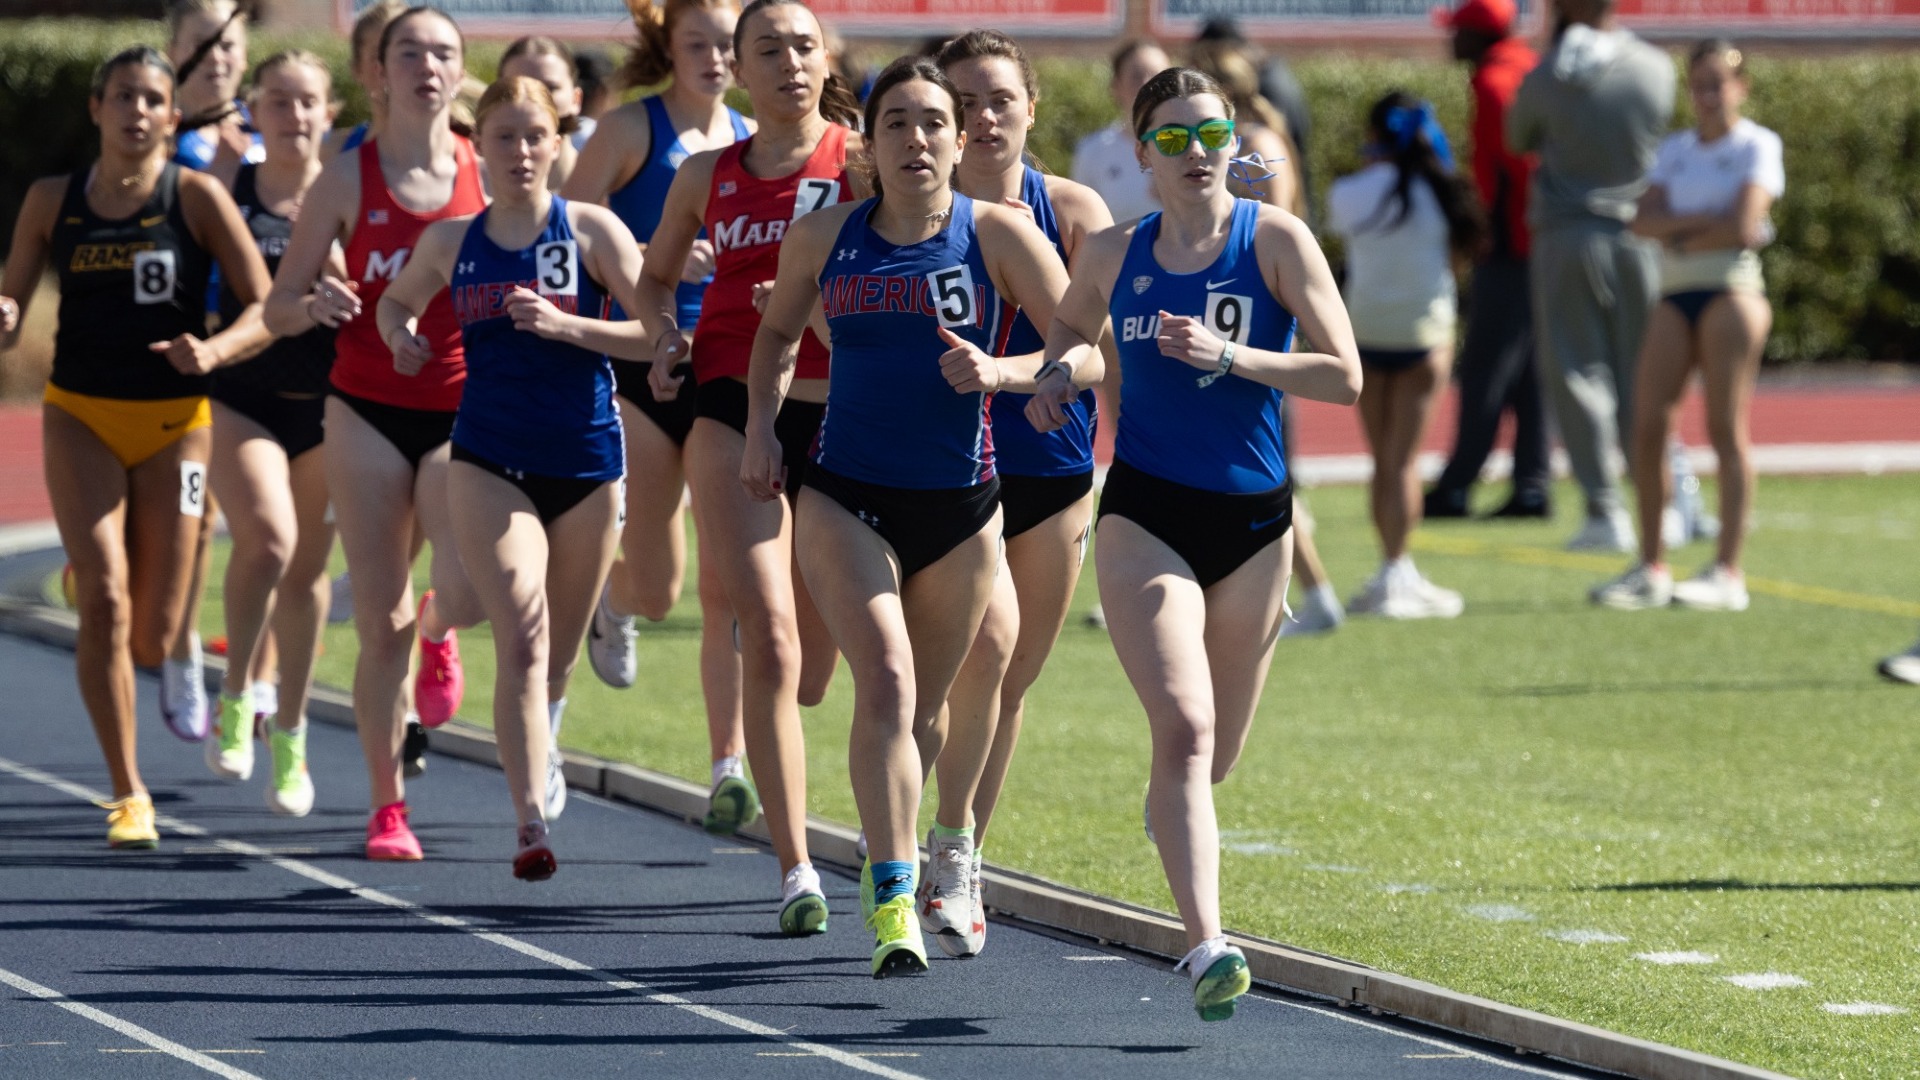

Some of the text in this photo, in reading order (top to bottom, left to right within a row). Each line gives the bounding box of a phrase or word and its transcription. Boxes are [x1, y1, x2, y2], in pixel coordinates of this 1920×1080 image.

[807, 180, 832, 212] 7
[142, 260, 169, 295] 8
[543, 244, 571, 290] 3
[822, 274, 986, 330] AMERICN
[935, 269, 971, 323] 5
[1214, 296, 1243, 344] 9
